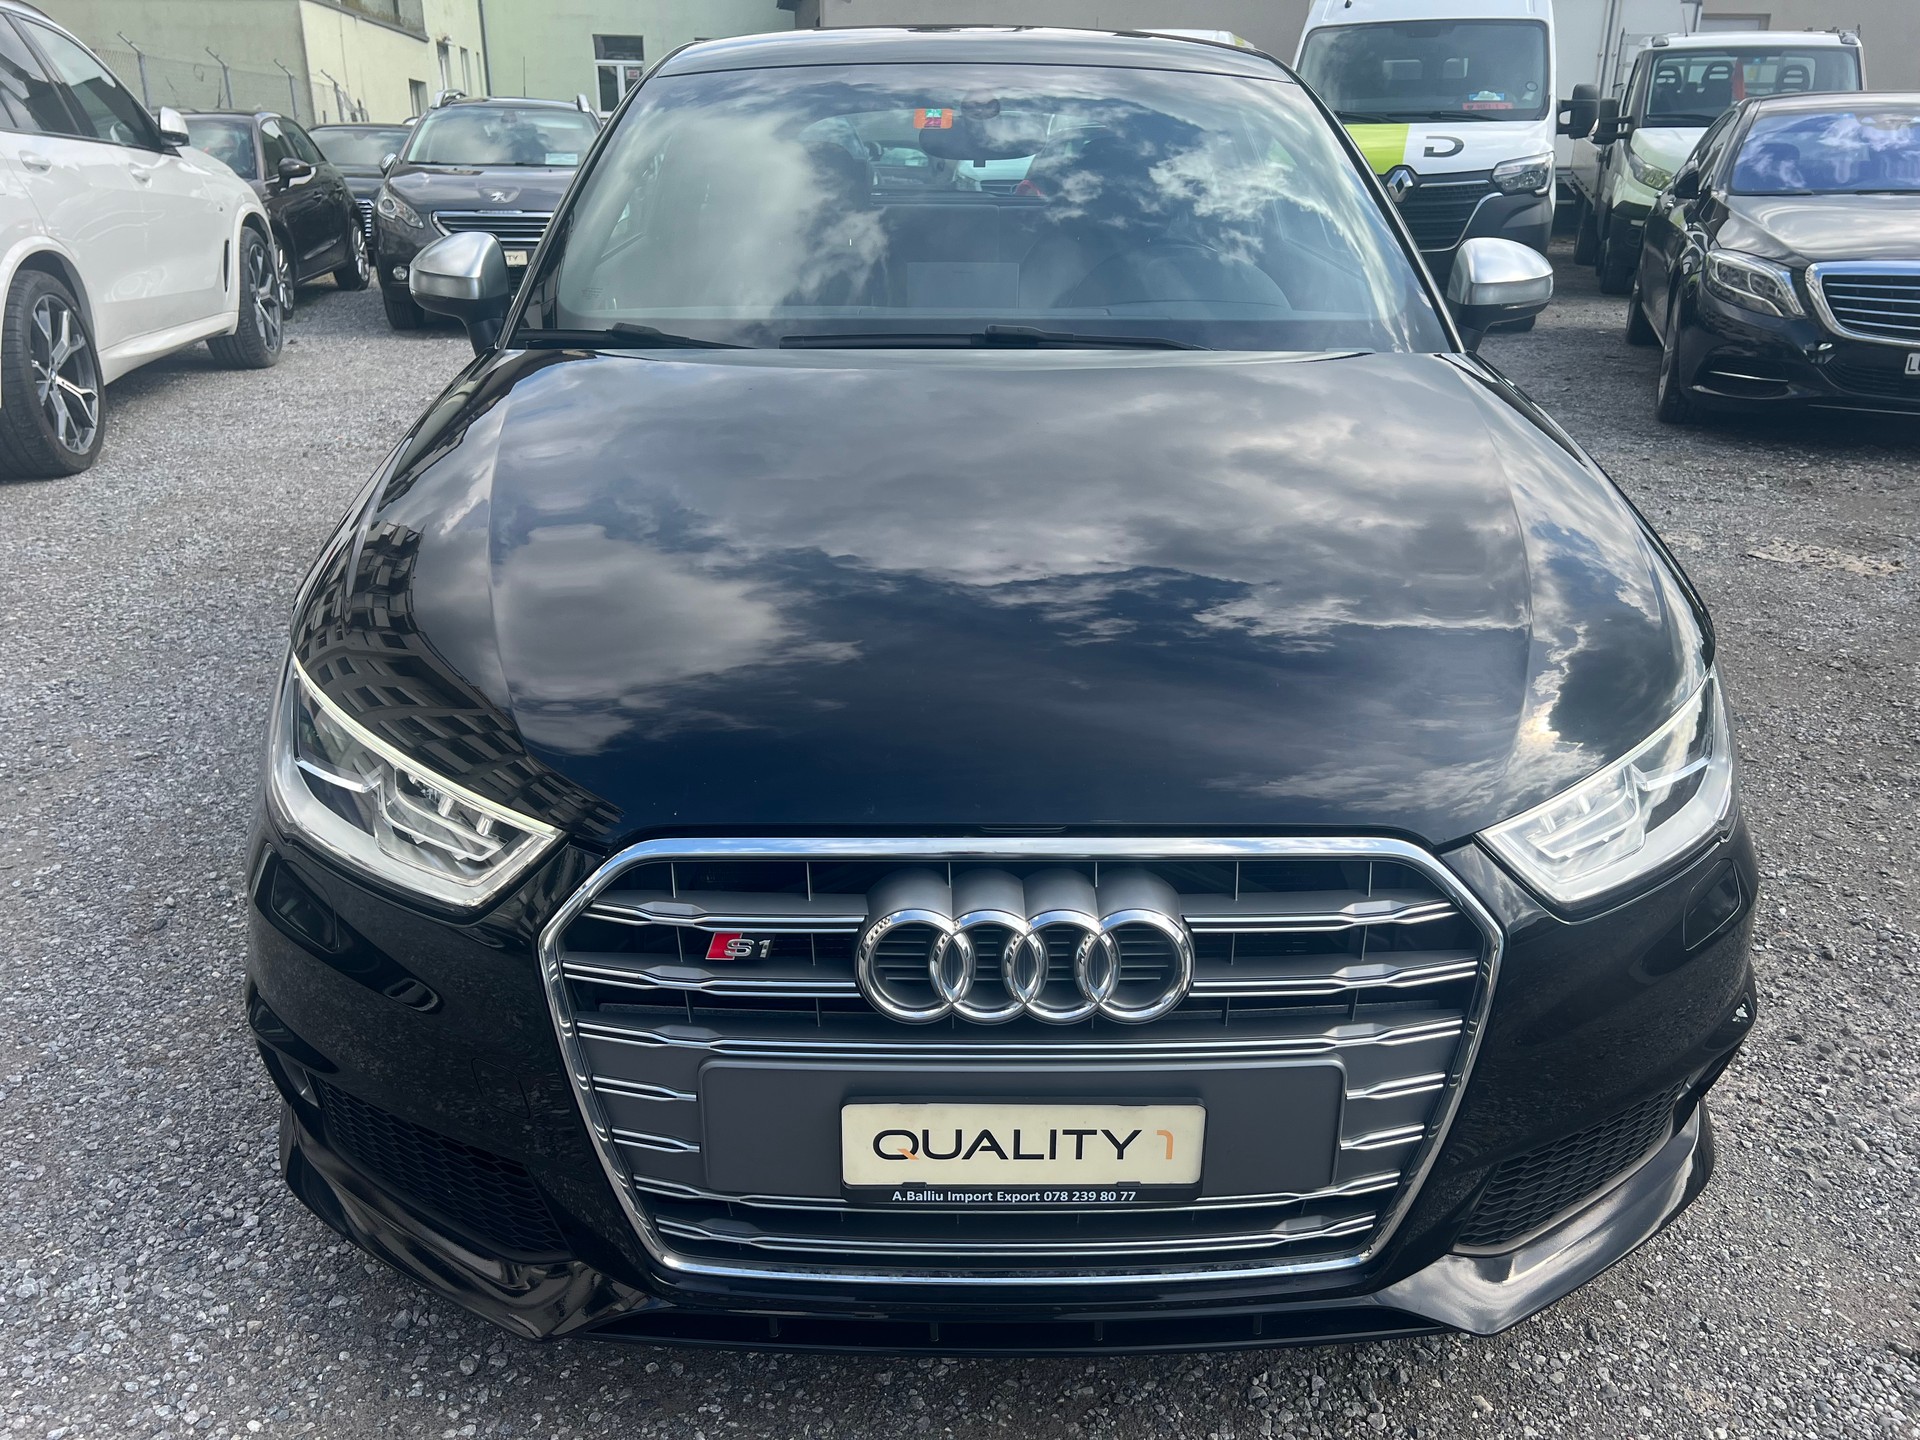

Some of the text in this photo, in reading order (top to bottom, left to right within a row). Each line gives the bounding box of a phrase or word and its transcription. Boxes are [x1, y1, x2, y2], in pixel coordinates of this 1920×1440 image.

[724, 938, 771, 958] S1
[872, 1128, 1174, 1161] QUALITY 1
[892, 1190, 1136, 1204] A.Balliu Import Export 078 239 80 77
